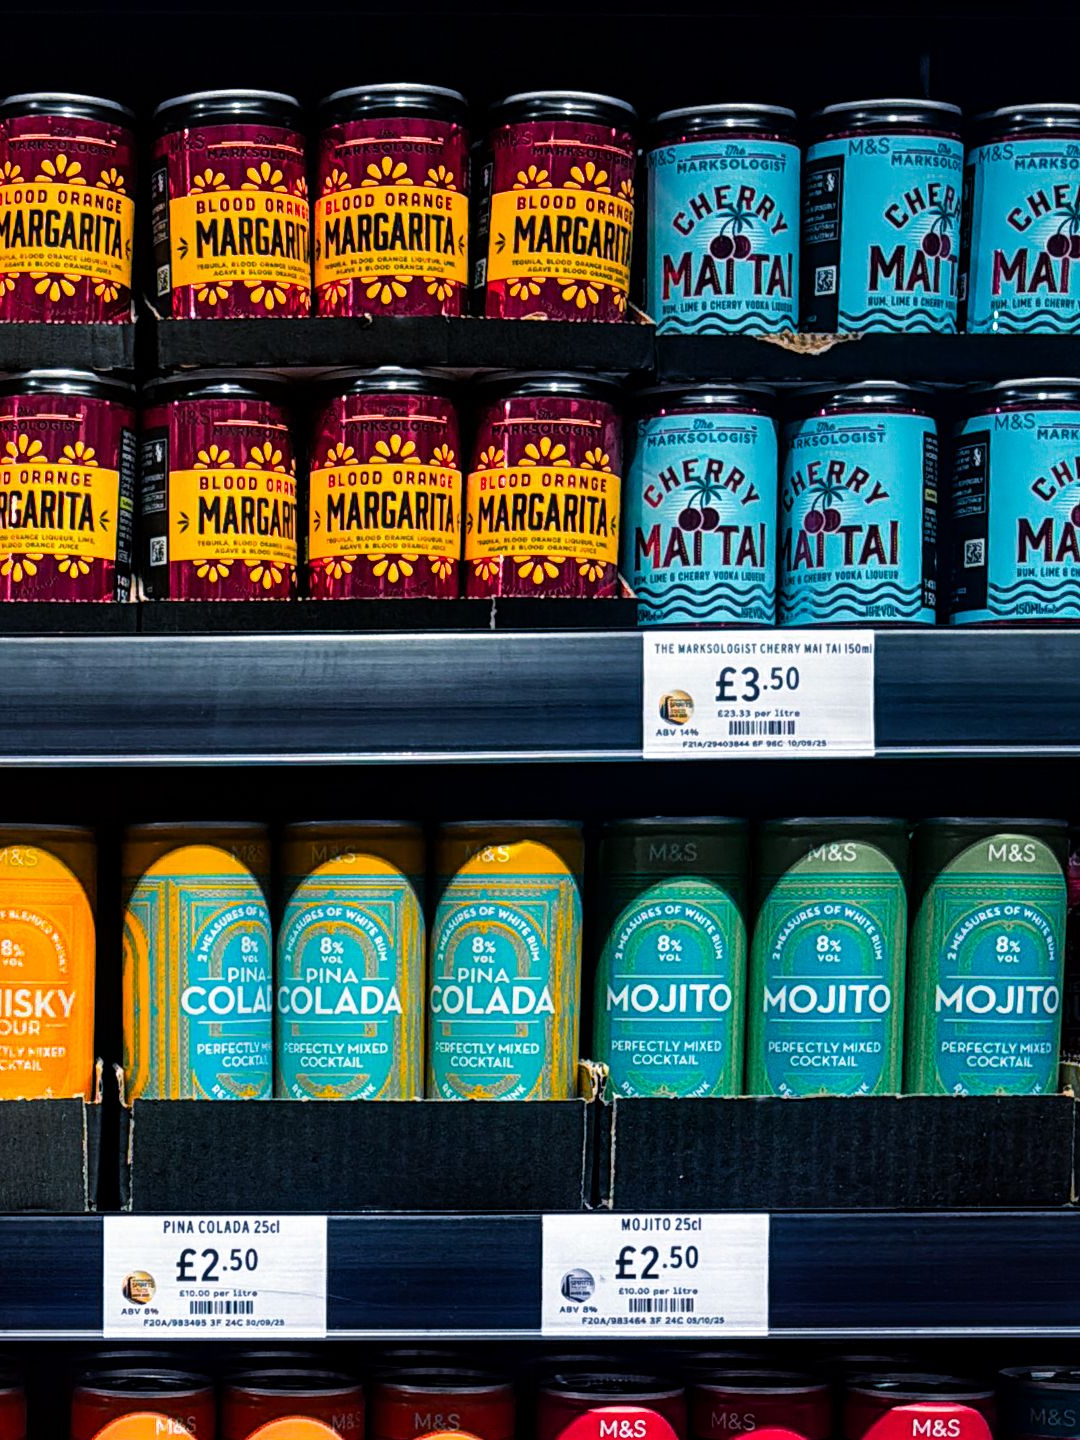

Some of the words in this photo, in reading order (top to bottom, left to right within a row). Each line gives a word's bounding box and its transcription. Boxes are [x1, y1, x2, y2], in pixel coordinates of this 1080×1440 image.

[676, 158, 787, 173] MARKSOLOGIST
[673, 185, 790, 235] CHERRY
[663, 256, 734, 299] MAI
[752, 253, 793, 298] TAI
[655, 644, 674, 653] THE
[678, 644, 757, 653] MARKSOLOGIST
[760, 644, 800, 654] CHERRY
[804, 644, 822, 654] MAI
[826, 644, 840, 653] TAI
[845, 644, 872, 654] 150ml
[715, 667, 799, 701] £3.50
[988, 843, 1036, 862] M&S
[472, 937, 496, 954] 8%
[473, 956, 495, 964] VOL
[457, 968, 510, 983] PINA
[430, 986, 555, 1014] COLADA
[935, 985, 1059, 1013] MOJITO
[435, 1043, 494, 1055] PERFECTLY
[498, 1042, 540, 1054] MIXED
[450, 1054, 514, 1068] COCKTAIL
[164, 1221, 194, 1233] PINA
[199, 1221, 249, 1233] COLADA
[254, 1220, 280, 1233] 25cl
[622, 1218, 671, 1231] MOJITO
[675, 1218, 701, 1231] 25cl
[176, 1248, 258, 1282] £2.50
[615, 1246, 698, 1279] £2.50
